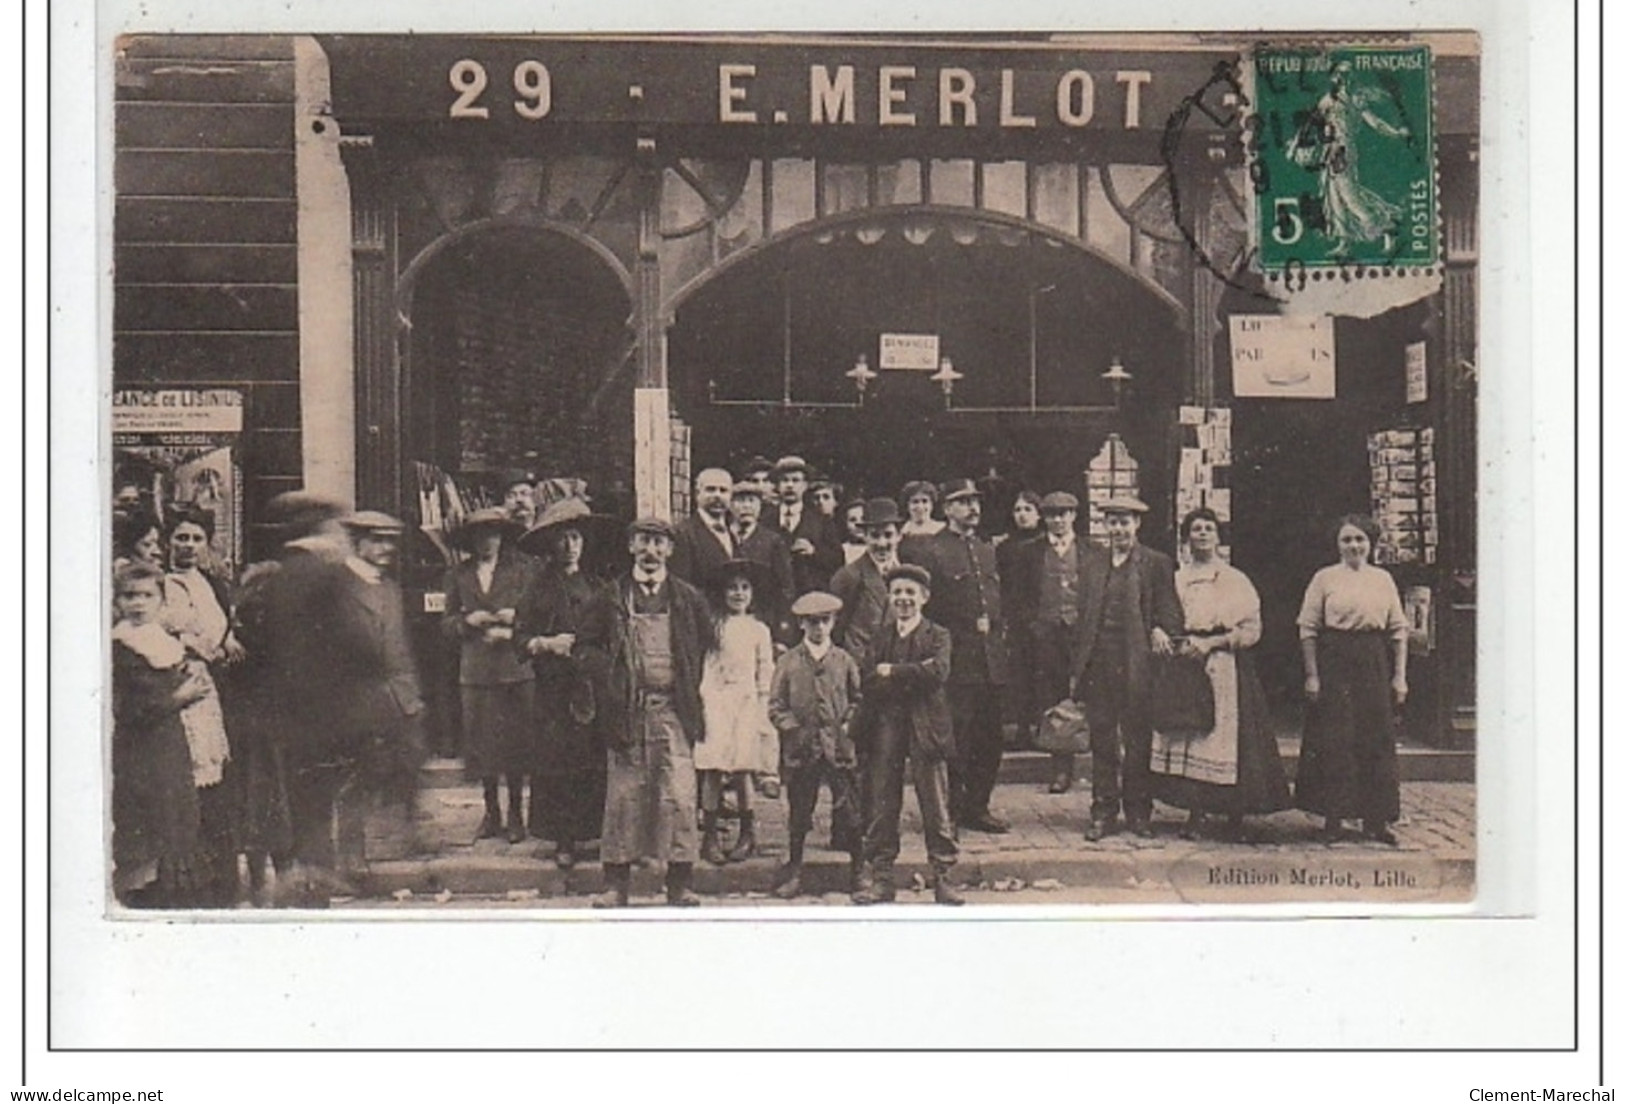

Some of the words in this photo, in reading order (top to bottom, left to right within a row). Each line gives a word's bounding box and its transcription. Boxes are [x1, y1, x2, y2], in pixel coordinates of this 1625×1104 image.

[449, 59, 551, 120] 29
[1271, 197, 1304, 245] 5
[1411, 178, 1429, 251] POSTES
